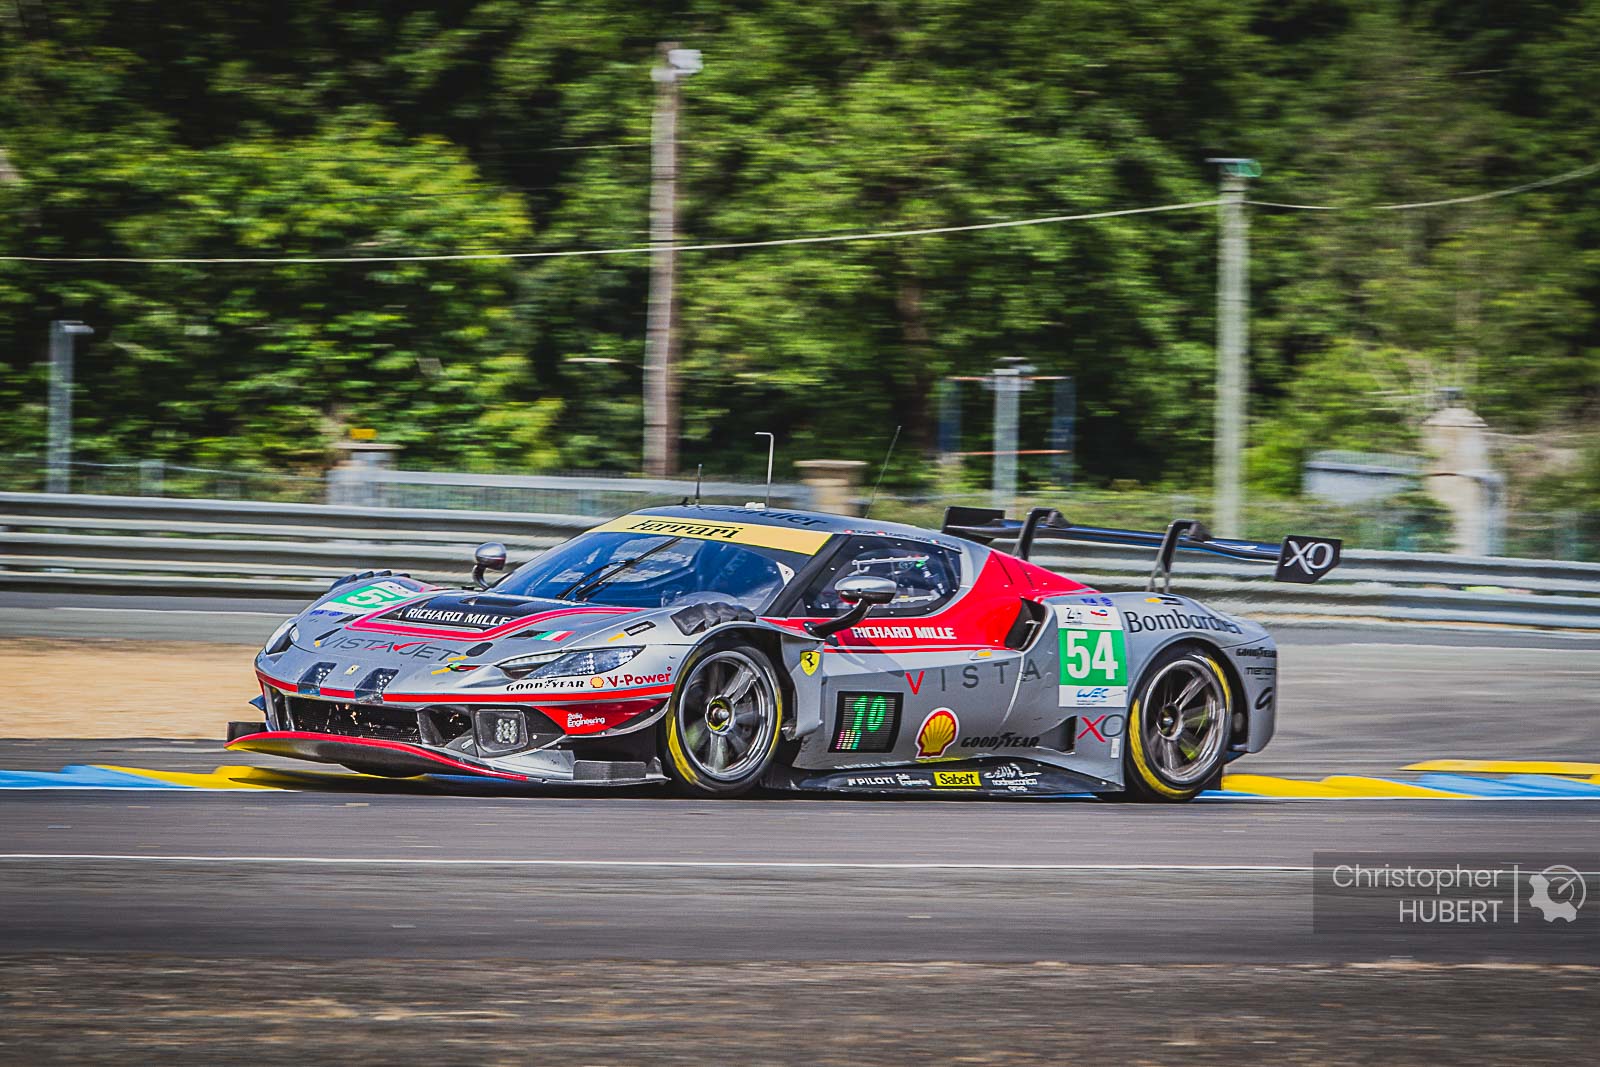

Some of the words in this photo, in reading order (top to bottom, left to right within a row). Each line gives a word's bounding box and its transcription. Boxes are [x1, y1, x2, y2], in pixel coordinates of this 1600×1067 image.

[627, 520, 744, 539] Ferrari
[1283, 540, 1335, 575] XO
[405, 608, 461, 622] RICHARD
[463, 614, 512, 626] MILLE
[1123, 608, 1243, 635] Bombardier
[852, 626, 913, 639] RICHARD
[915, 627, 957, 640] MILLE
[1066, 630, 1118, 680] 54
[506, 679, 585, 692] GOODYEAR
[607, 671, 672, 688] V-Power
[905, 658, 1041, 696] VISTA
[567, 717, 606, 728] Engineering
[1077, 713, 1125, 743] XO
[961, 732, 1040, 750] GOODYEAR
[940, 773, 976, 785] Sabelt
